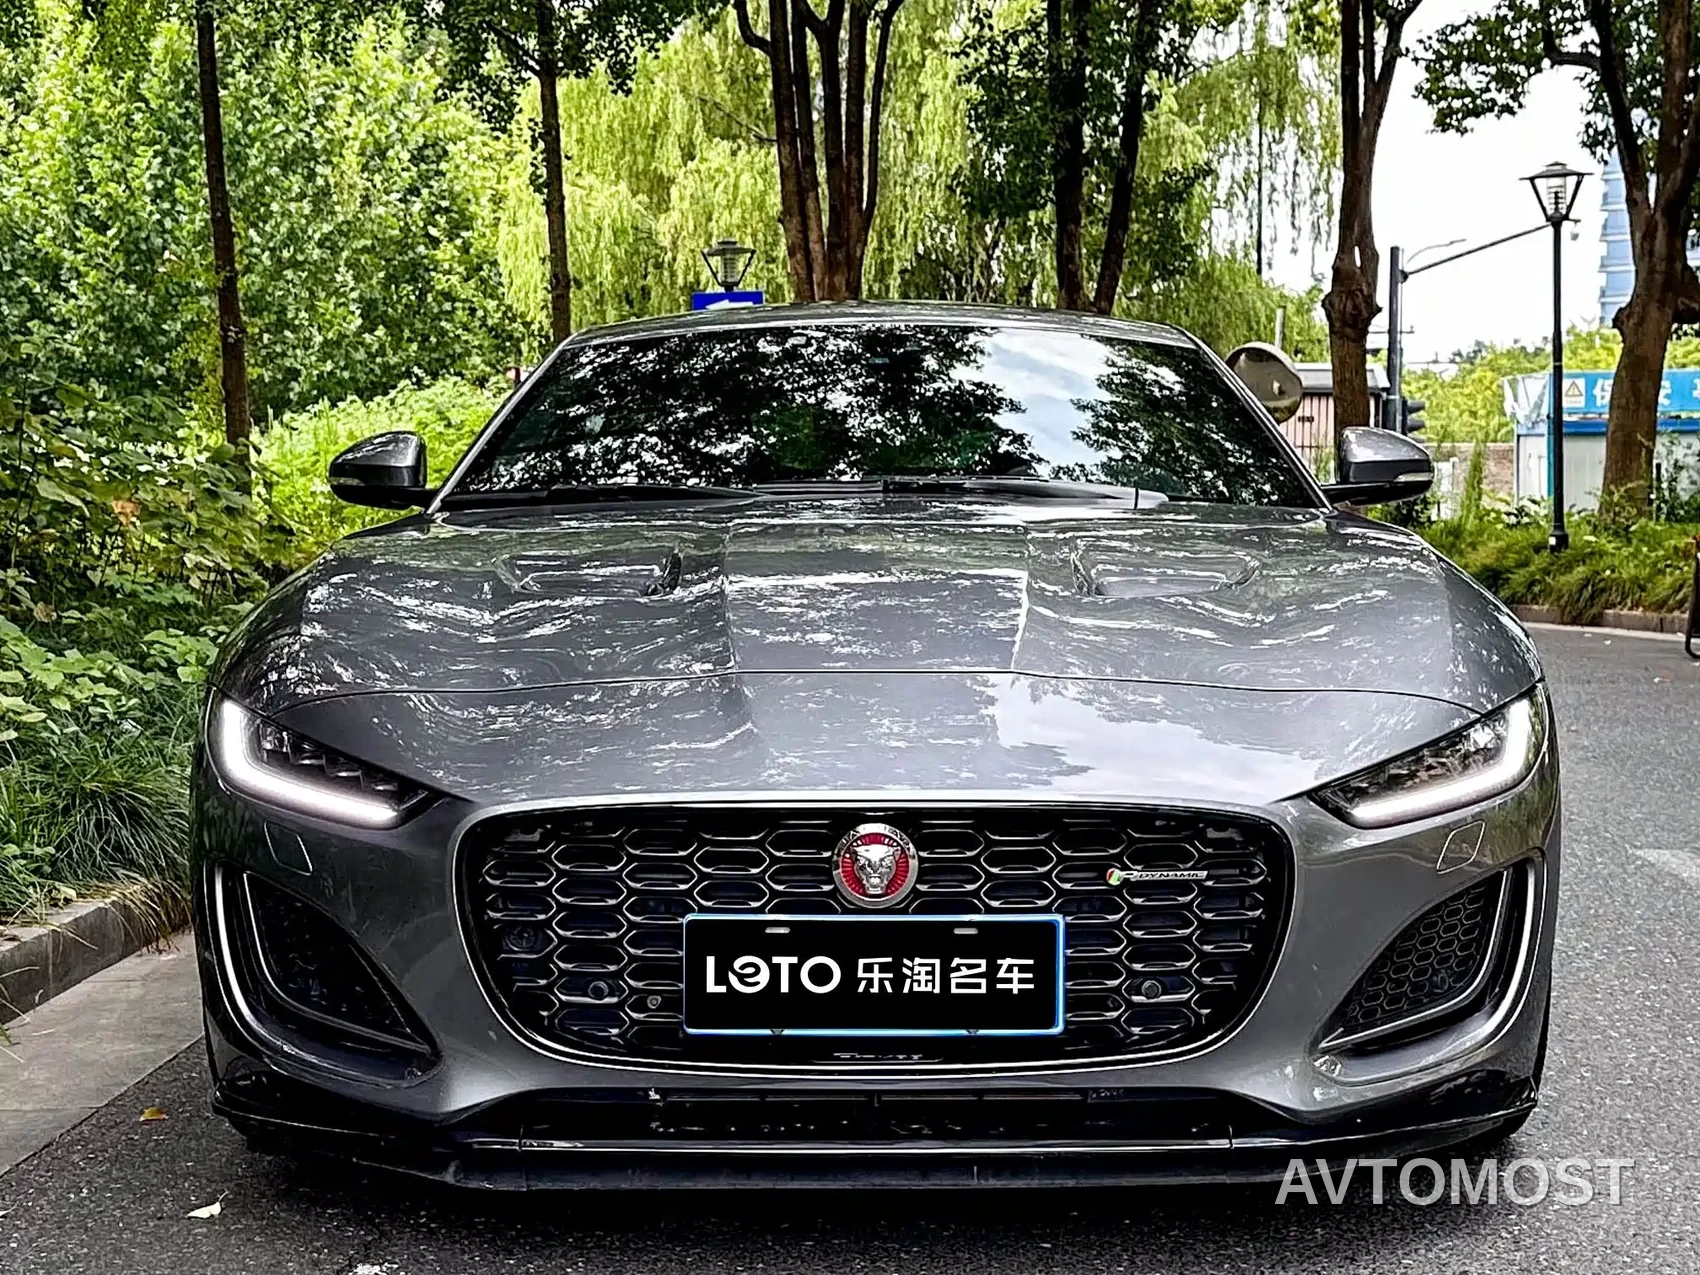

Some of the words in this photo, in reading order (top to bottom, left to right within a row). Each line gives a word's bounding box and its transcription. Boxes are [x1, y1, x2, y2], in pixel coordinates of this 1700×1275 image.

[706, 955, 842, 994] LOTO
[857, 956, 1035, 994] 乐淘名车
